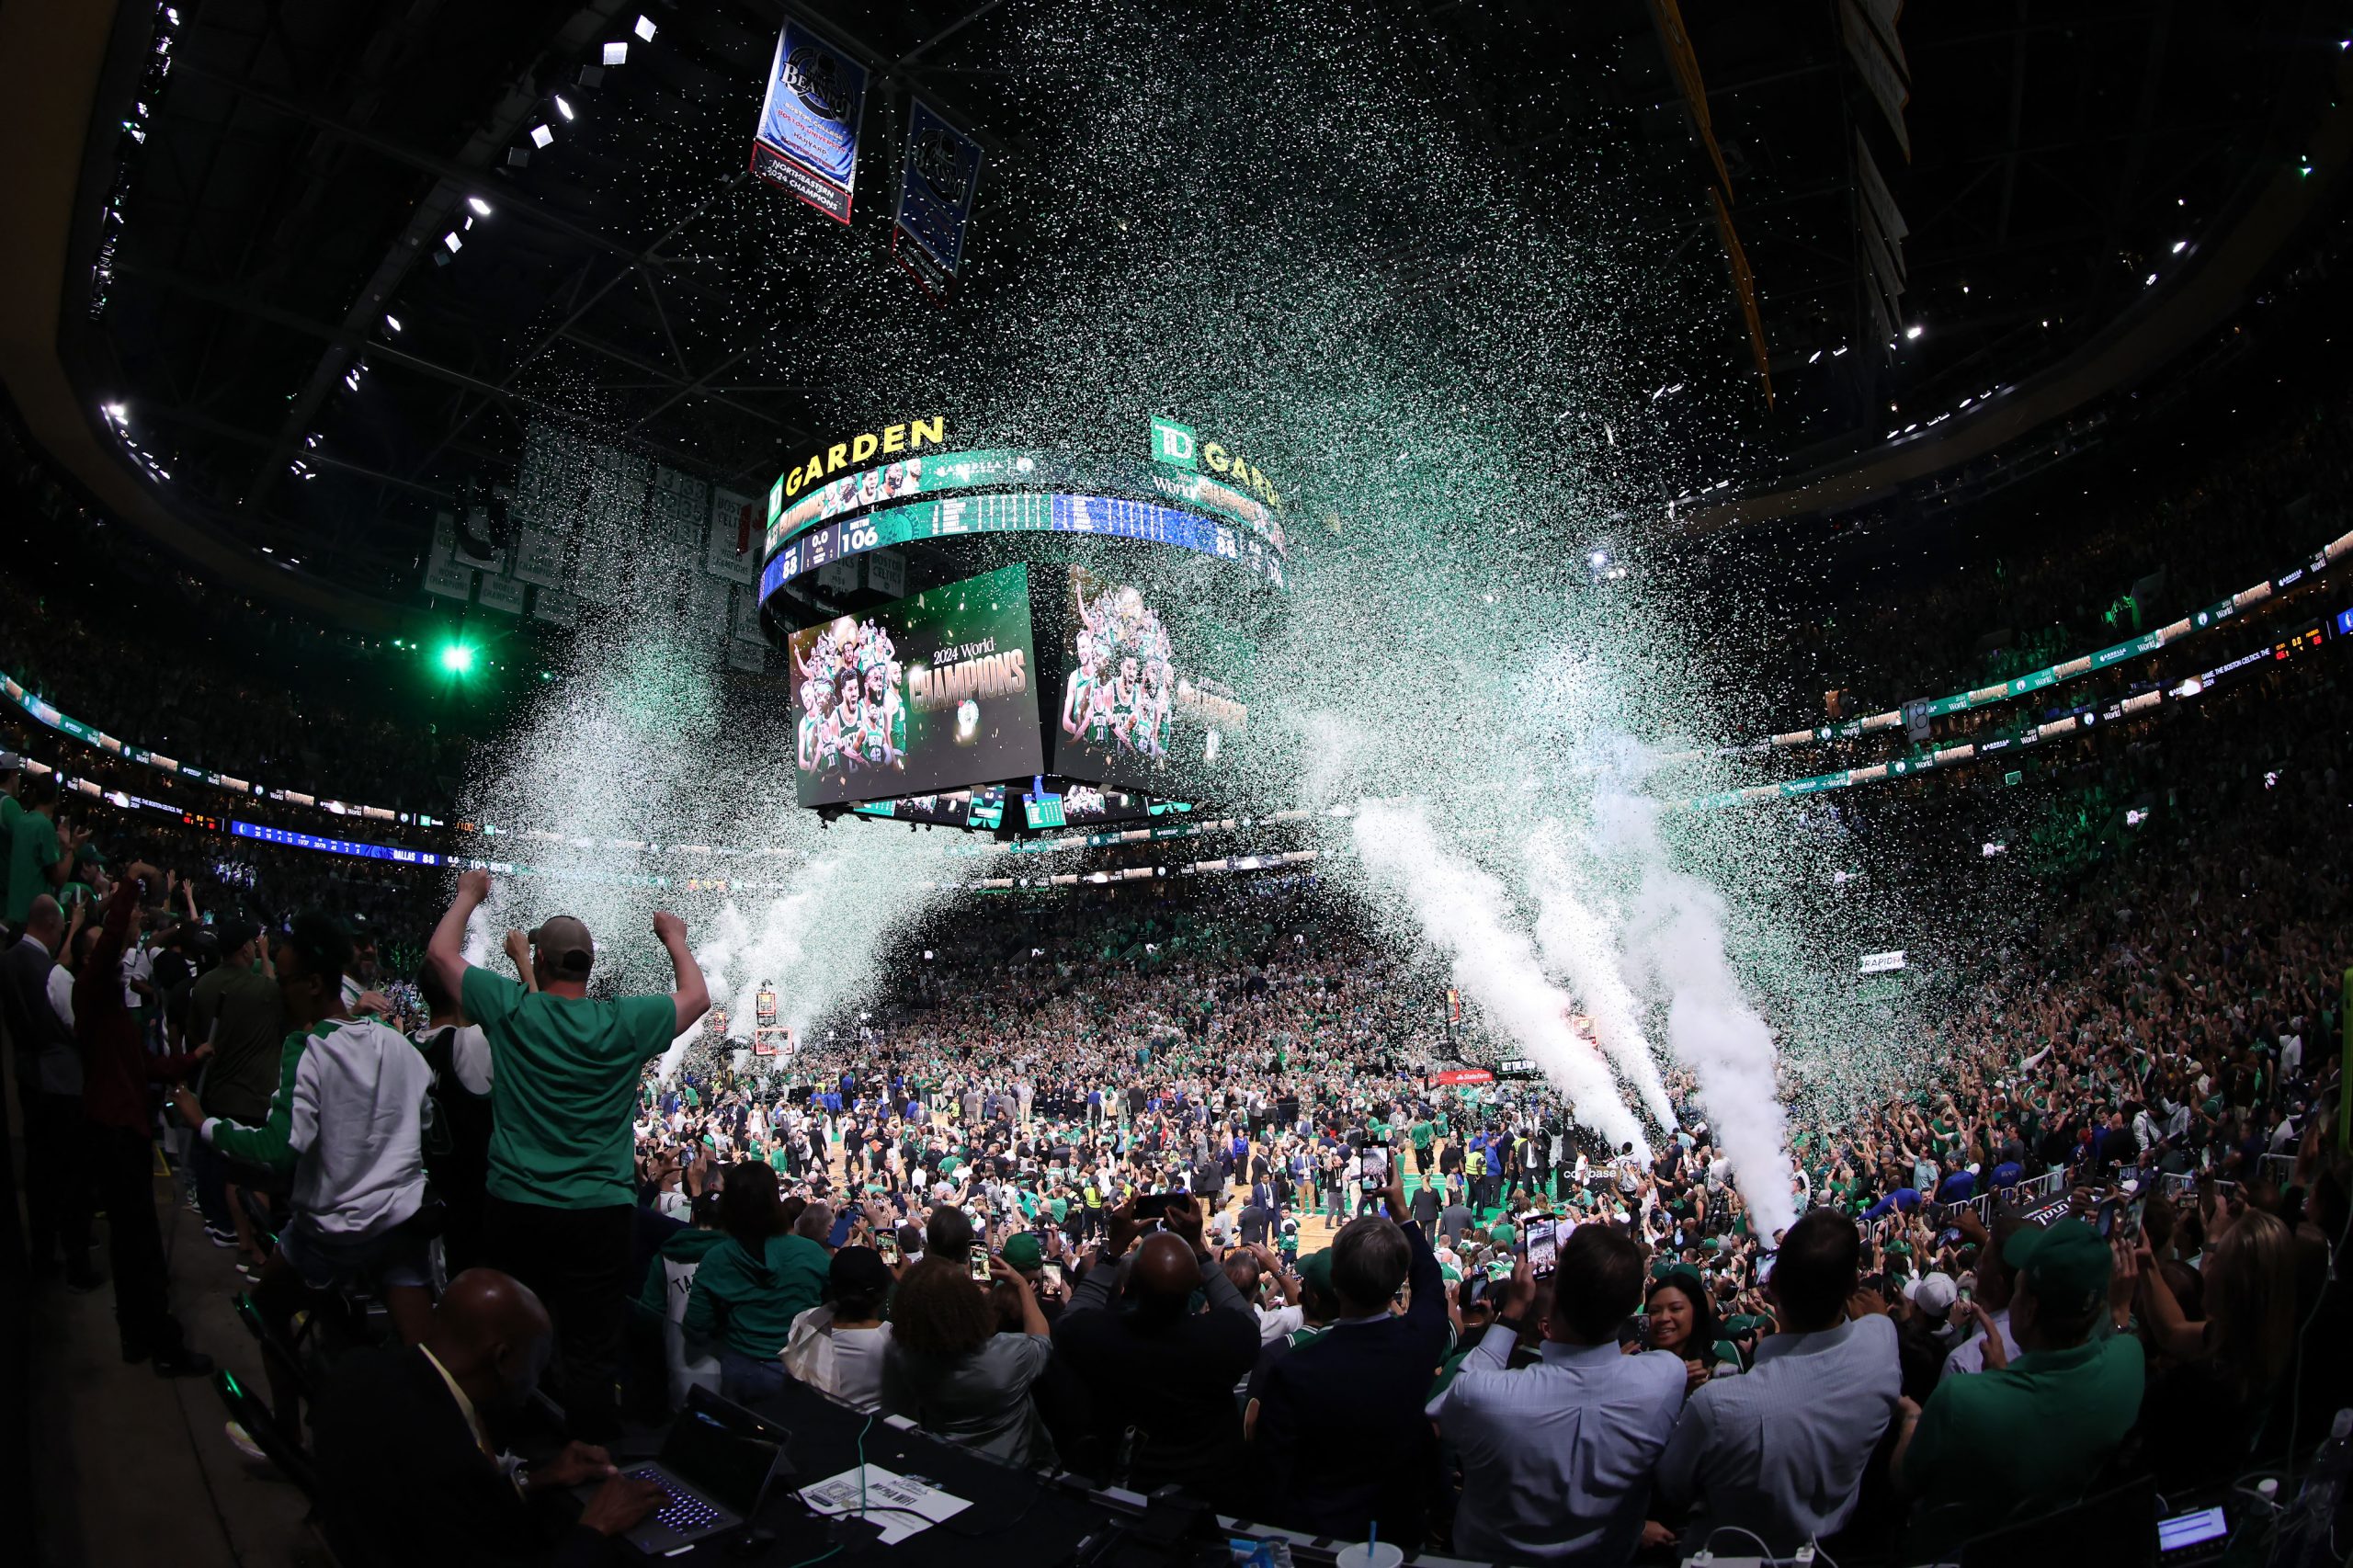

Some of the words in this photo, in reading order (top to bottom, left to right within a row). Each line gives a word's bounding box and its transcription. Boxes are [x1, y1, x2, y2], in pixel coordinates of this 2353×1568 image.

[778, 109, 805, 131] BOSTON
[807, 127, 847, 153] UNIVERSITY
[813, 120, 844, 142] COLLEGE
[793, 131, 827, 154] HARVARD
[772, 159, 835, 199] NORTHEASTERN
[767, 165, 789, 183] 2024
[789, 179, 838, 210] CHAMPIONS
[1155, 424, 1193, 460] TD
[785, 416, 944, 497] GARDEN
[812, 530, 829, 548] 0.0
[842, 527, 879, 553] 106
[1216, 535, 1237, 560] 88
[782, 555, 798, 580] 88
[2310, 558, 2326, 574] World
[2216, 606, 2234, 619] World
[933, 645, 959, 665] 2024
[960, 636, 995, 658] World
[2137, 640, 2155, 653] World
[2214, 666, 2224, 676] THE
[2223, 658, 2243, 673] BOSTON
[2260, 647, 2271, 657] THE
[908, 648, 1027, 714] CHAMPIONS
[2034, 676, 2052, 687] World
[2202, 678, 2215, 688] 2024
[1948, 700, 1968, 711] World
[1904, 702, 1928, 733] 18
[2103, 709, 2121, 722] World
[1841, 725, 1860, 736] World
[2020, 733, 2038, 745] World
[870, 747, 881, 763] 42
[1915, 759, 1933, 770] World
[1827, 777, 1847, 787] World
[269, 791, 284, 801] World
[347, 808, 362, 817] World
[392, 849, 416, 862] DALLAS
[422, 854, 435, 865] 88
[447, 856, 460, 864] 0.0
[1563, 1167, 1617, 1179] cobase
[892, 1494, 918, 1506] WIFI
